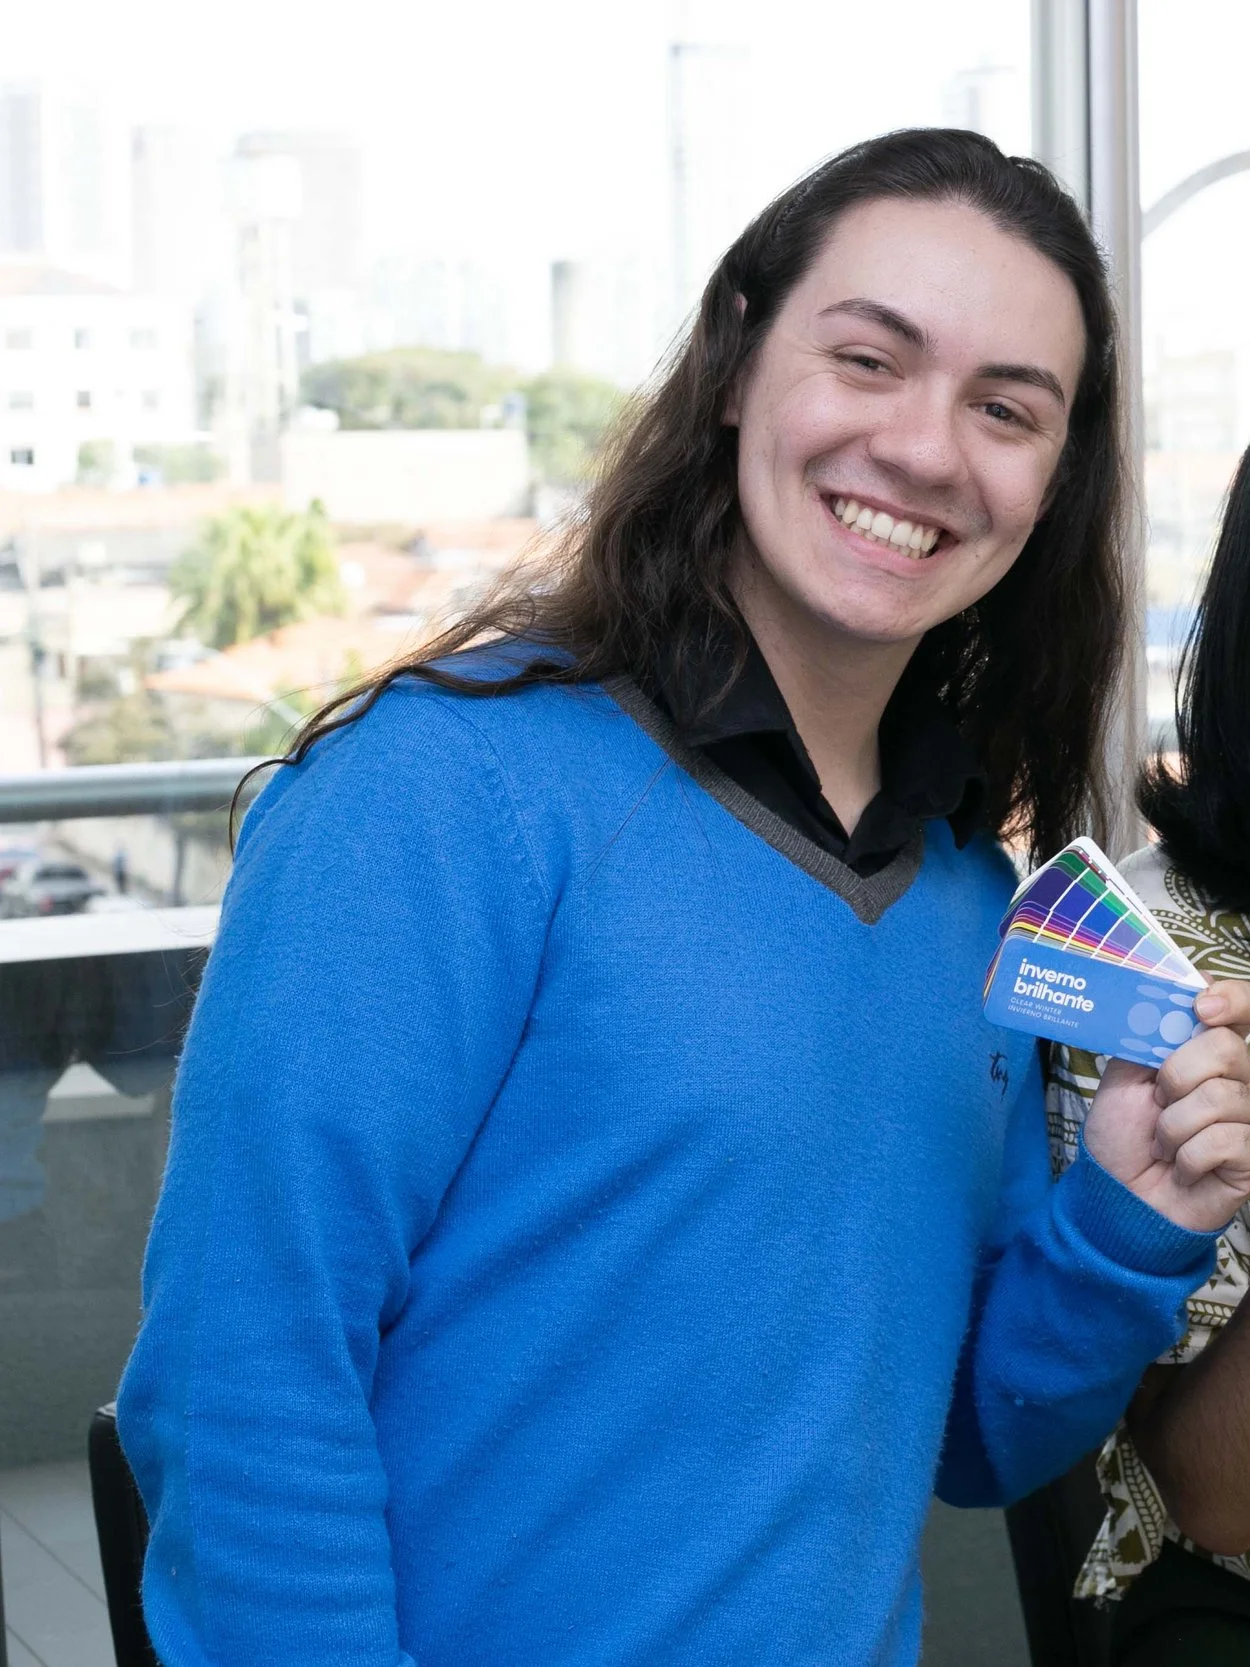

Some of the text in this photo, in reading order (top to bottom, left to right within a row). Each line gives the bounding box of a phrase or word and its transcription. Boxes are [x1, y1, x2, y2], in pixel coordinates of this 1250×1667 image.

[1019, 958, 1087, 991] inverno
[1010, 997, 1062, 1015] CLEAR WINTER
[1013, 977, 1095, 1012] brilhante
[1007, 1004, 1080, 1029] INVIERNO BRILLANTE
